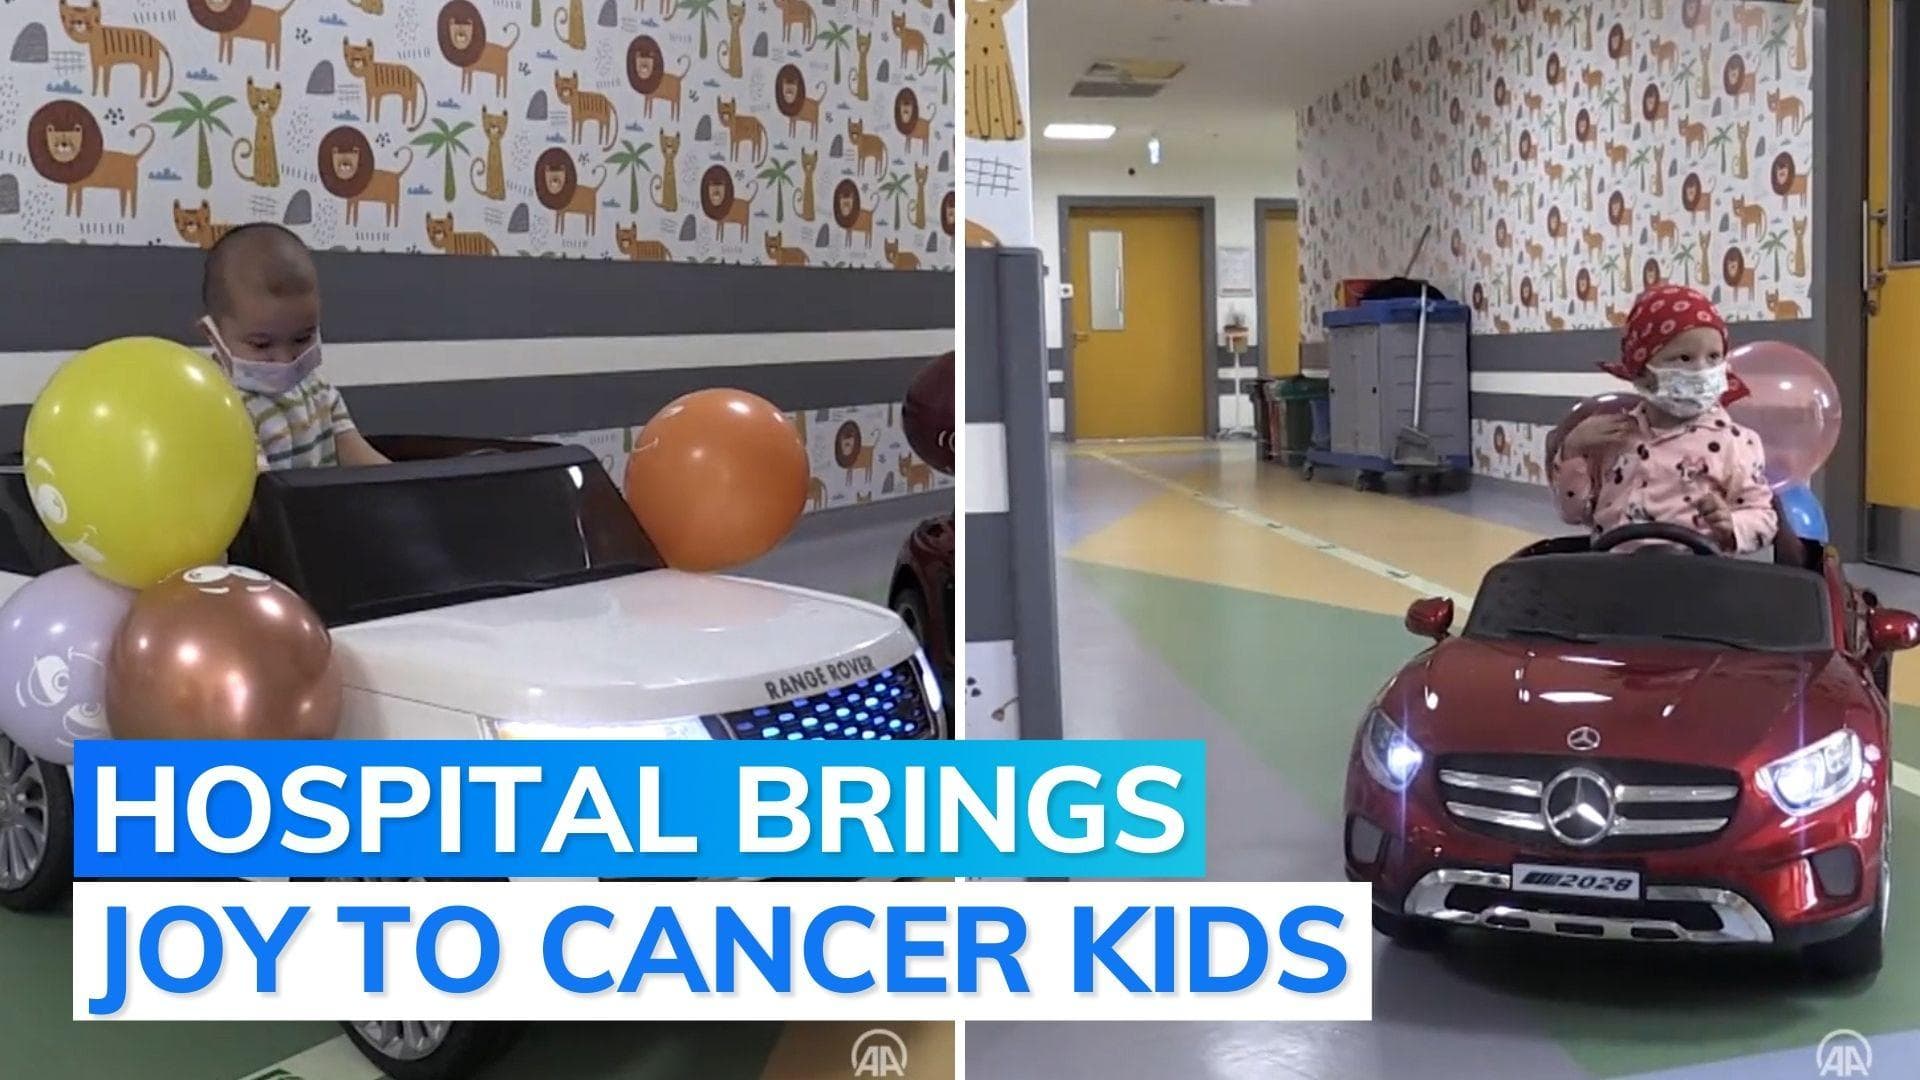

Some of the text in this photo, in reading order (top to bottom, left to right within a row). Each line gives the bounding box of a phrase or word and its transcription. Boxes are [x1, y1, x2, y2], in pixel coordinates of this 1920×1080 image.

[764, 655, 877, 700] RANGE ROVER
[1558, 873, 1633, 892] 2028
